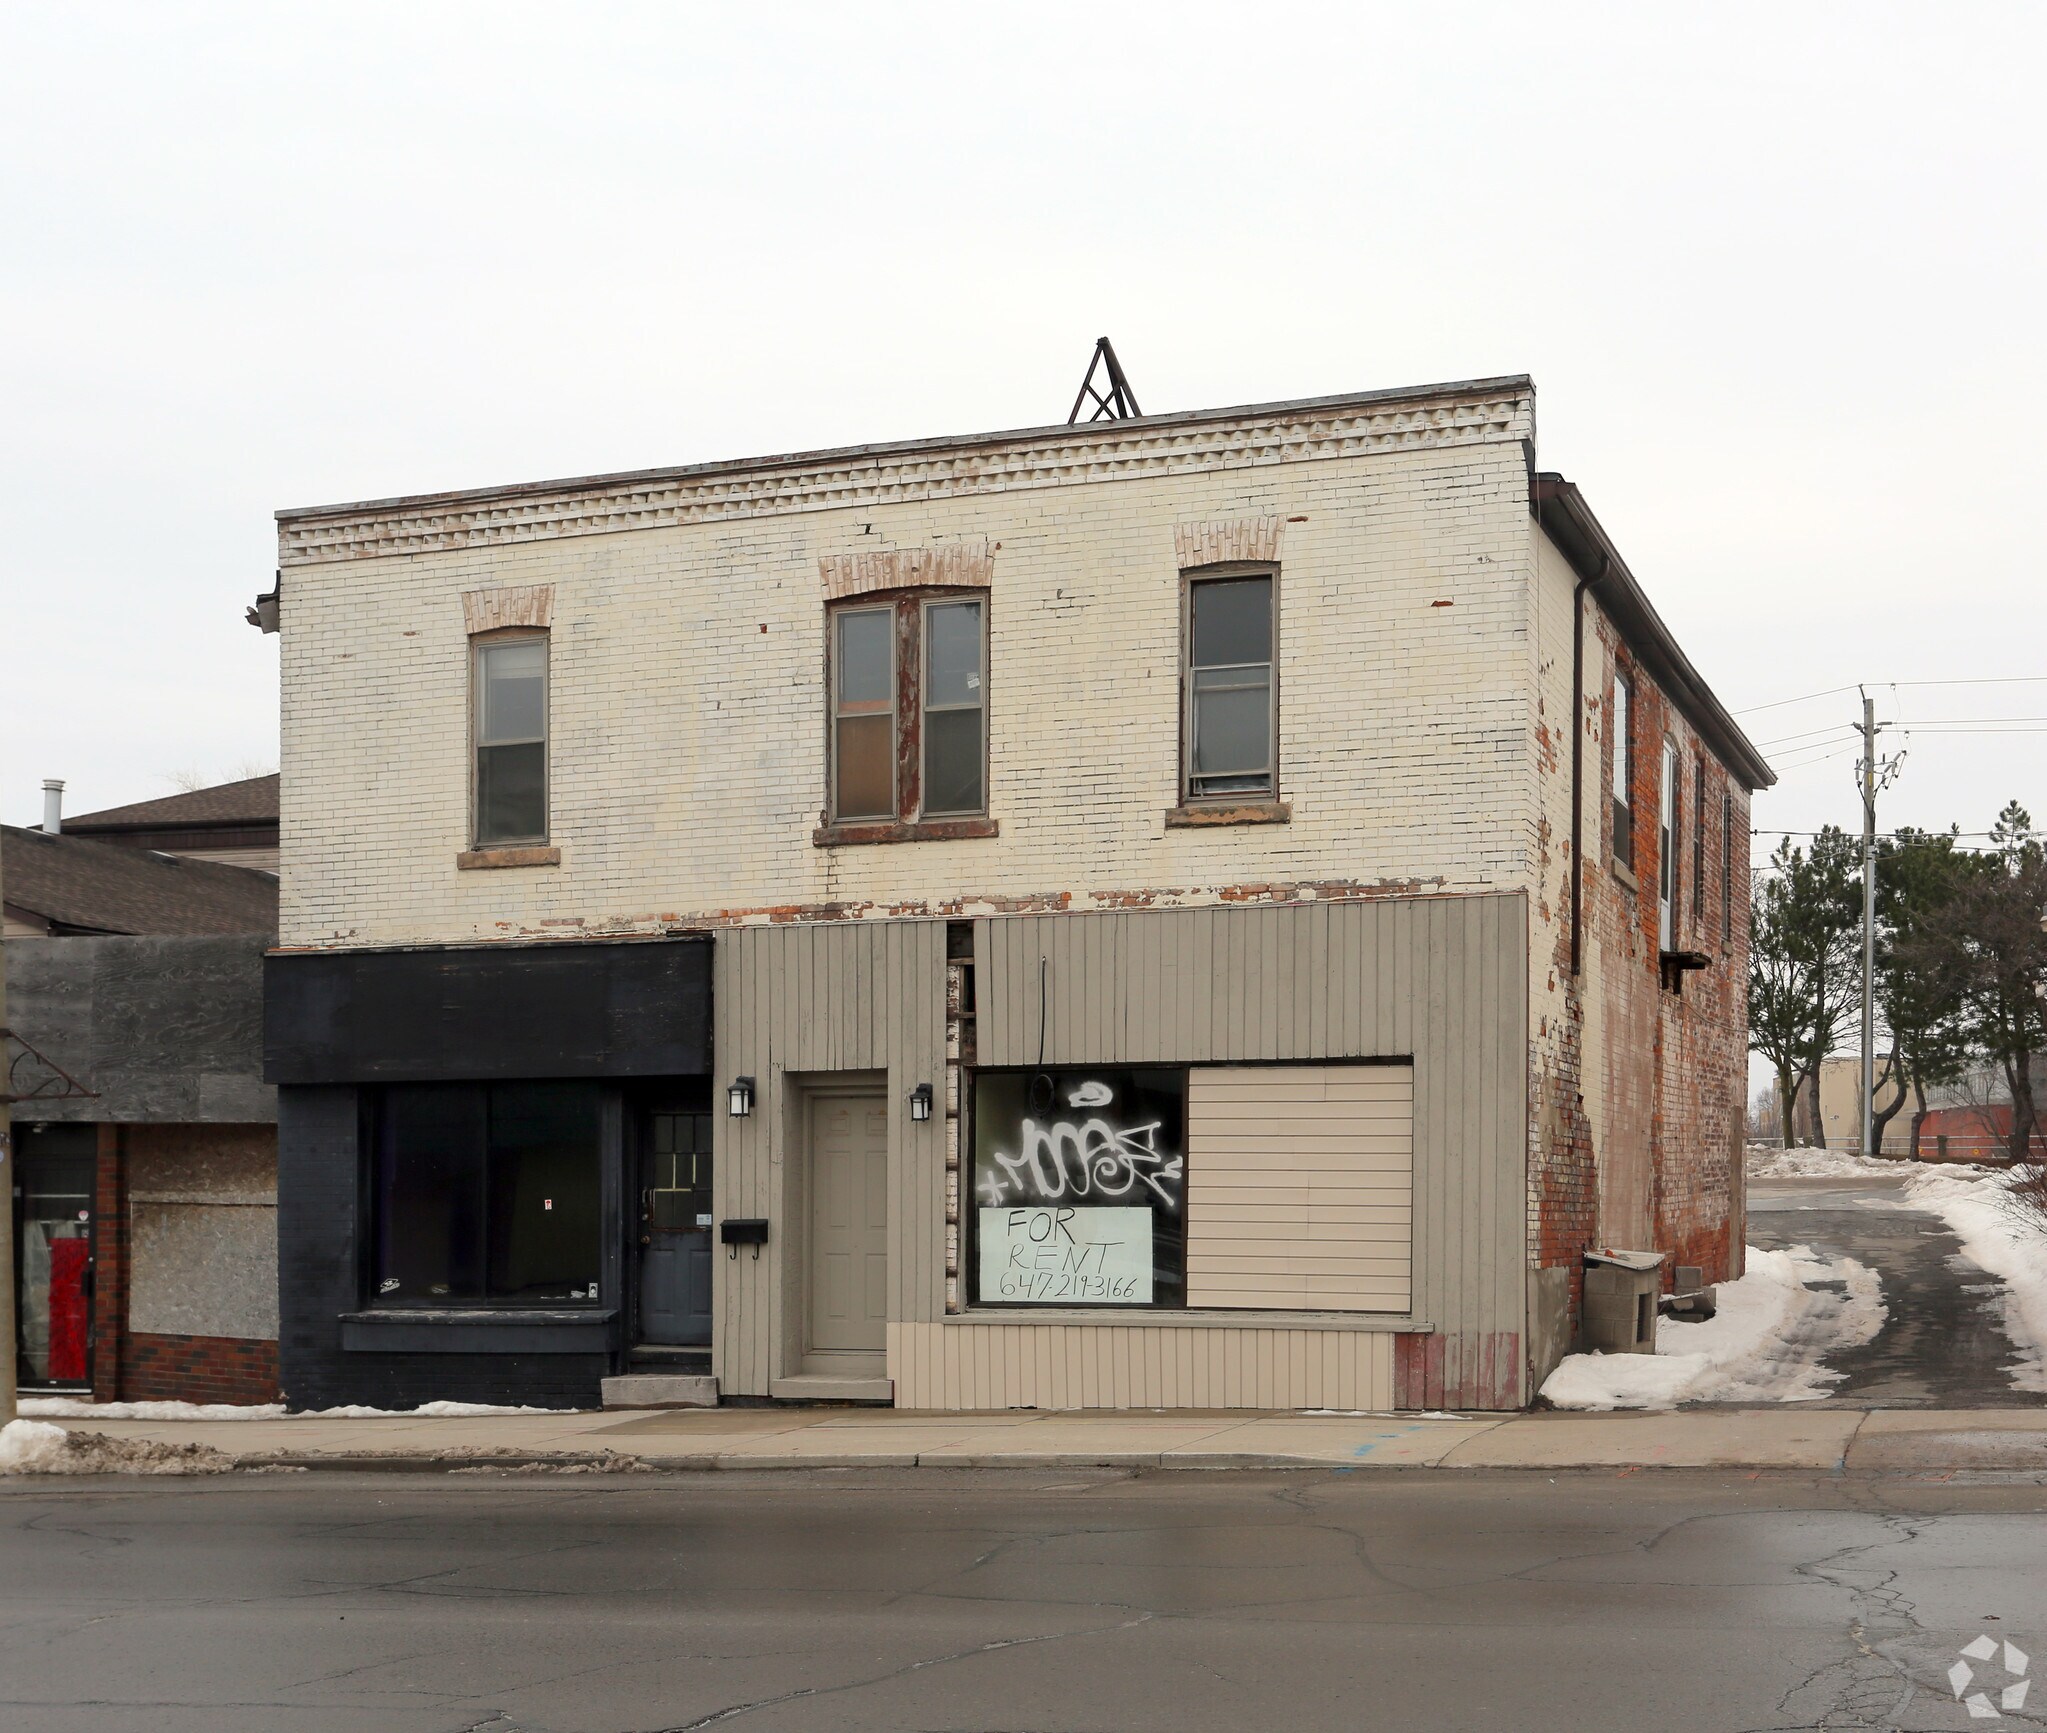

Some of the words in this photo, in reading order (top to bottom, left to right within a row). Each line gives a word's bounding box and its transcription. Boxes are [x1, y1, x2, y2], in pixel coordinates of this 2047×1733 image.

[1007, 1207, 1076, 1245] FOR
[1008, 1241, 1126, 1274] RENT
[999, 1271, 1138, 1299] 647-219-3166
